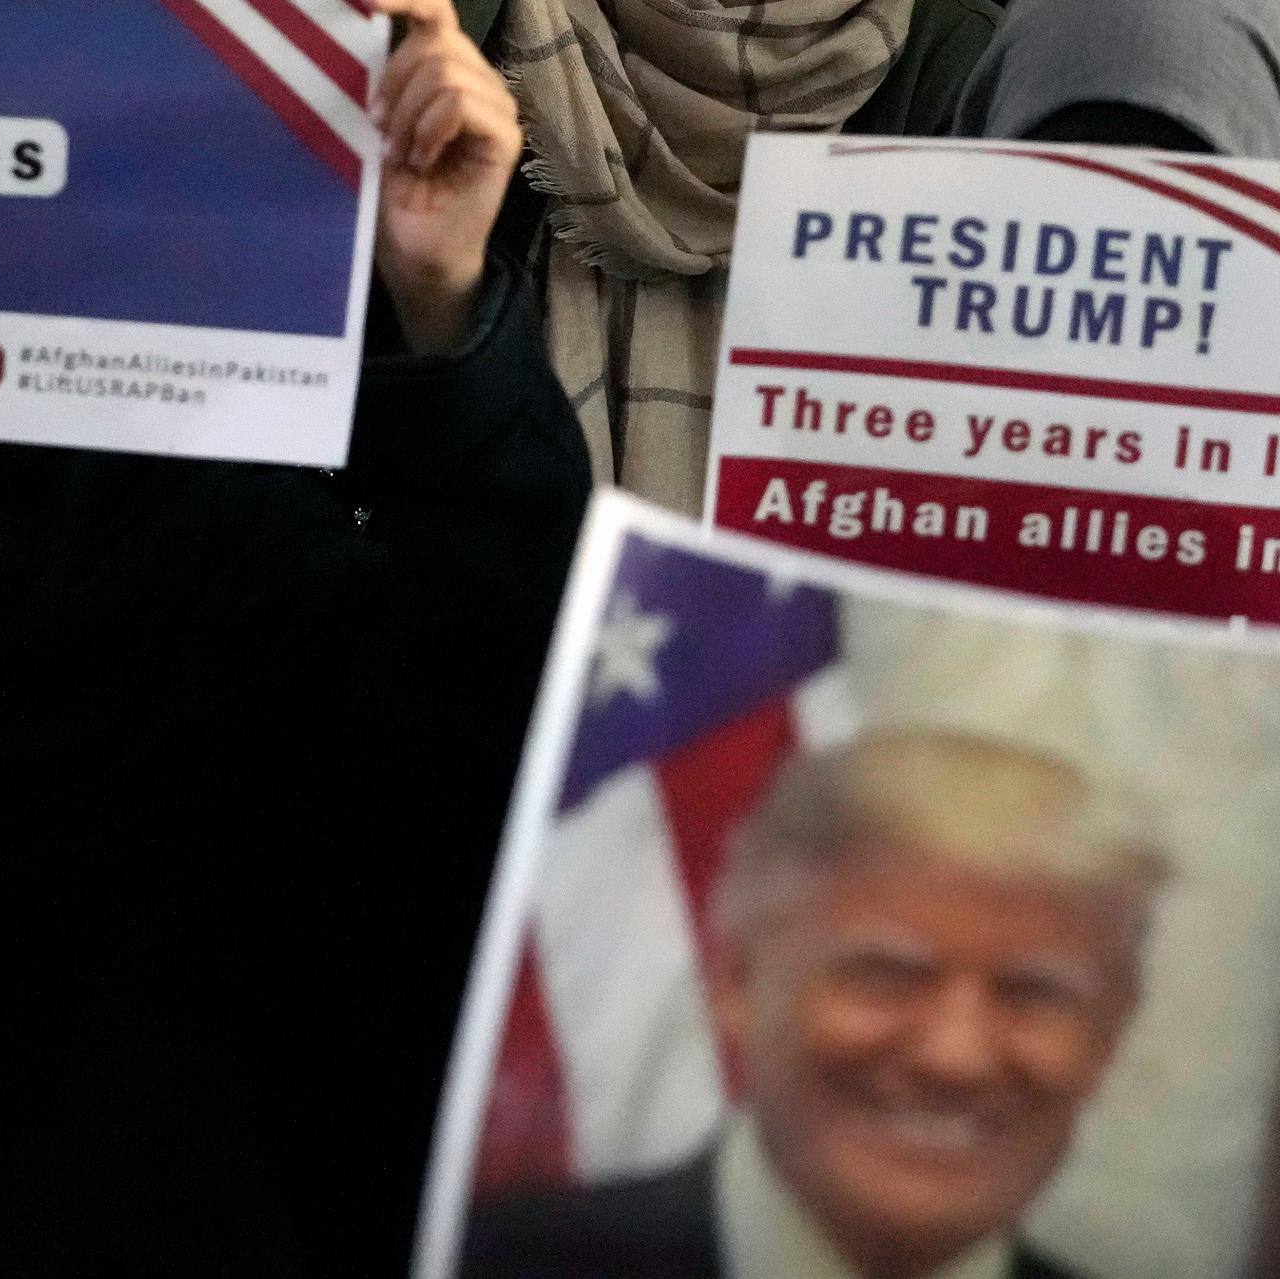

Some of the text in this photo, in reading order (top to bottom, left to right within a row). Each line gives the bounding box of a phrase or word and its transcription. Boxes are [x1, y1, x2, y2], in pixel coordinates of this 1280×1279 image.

[791, 210, 1234, 292] PRESIDENT
[909, 275, 1217, 355] TRUMP!
[20, 345, 331, 388] #AfghanAlliesInPakistan
[754, 384, 937, 443] Three
[964, 402, 1144, 466] years
[1175, 424, 1232, 472] in
[753, 476, 988, 543] Afghan
[1017, 504, 1208, 567] allies
